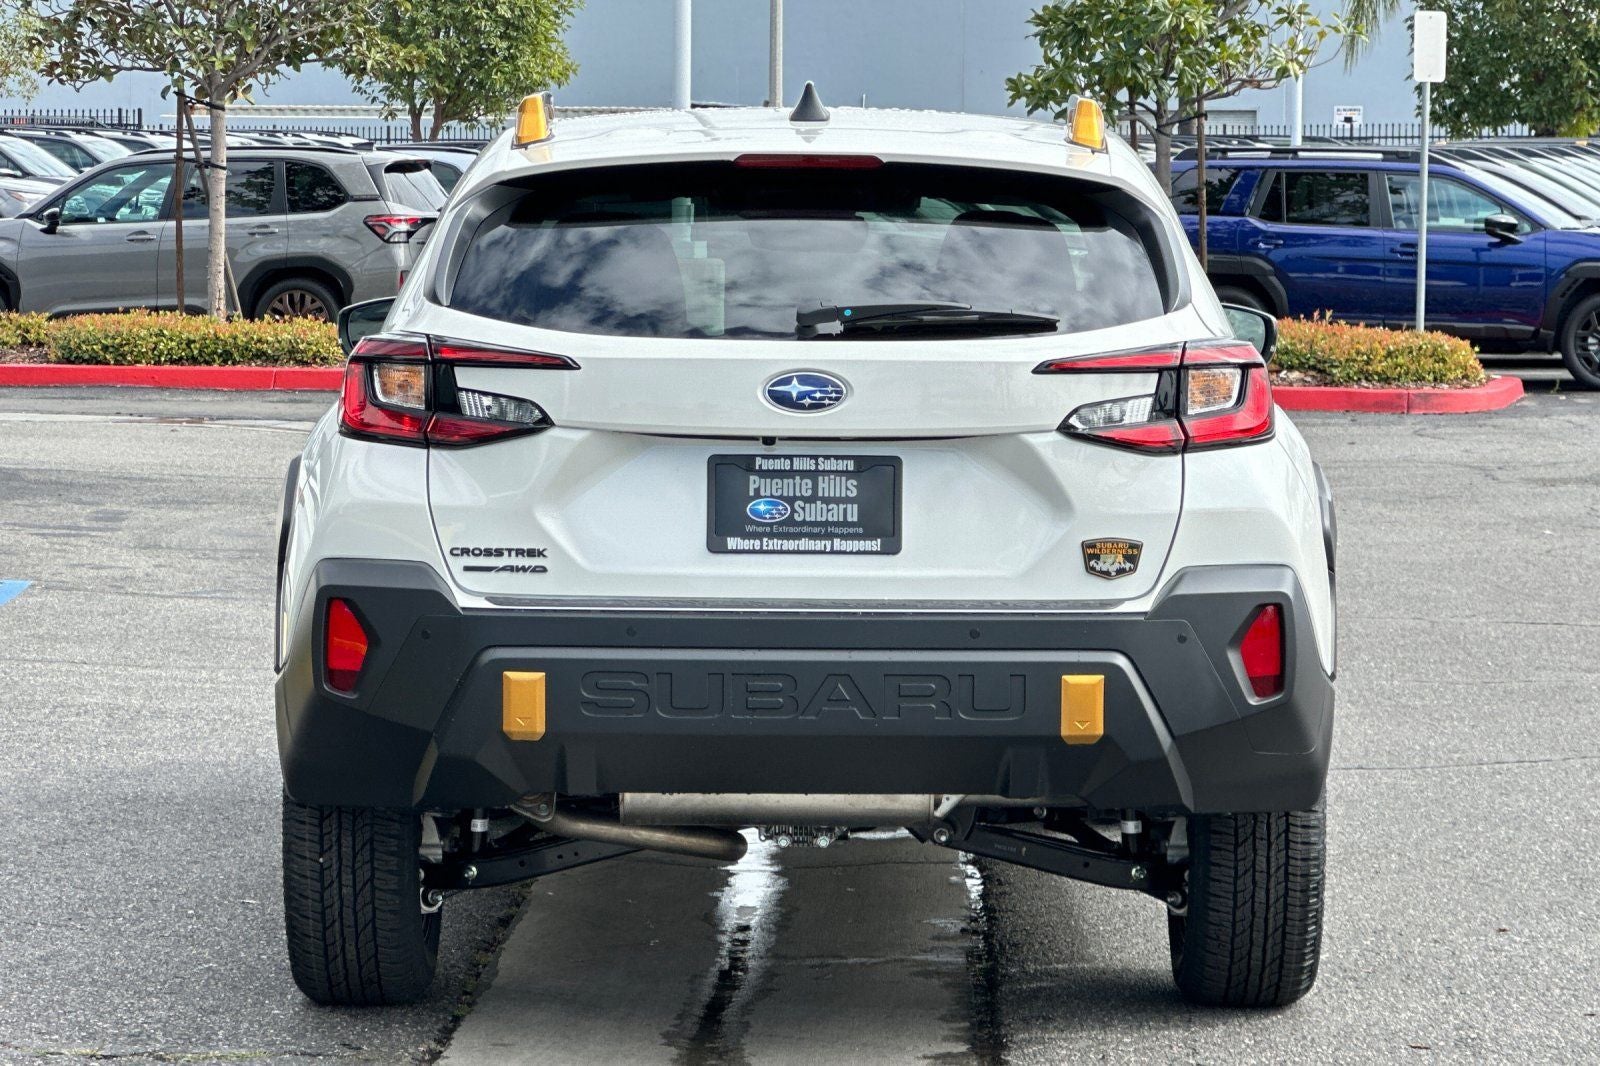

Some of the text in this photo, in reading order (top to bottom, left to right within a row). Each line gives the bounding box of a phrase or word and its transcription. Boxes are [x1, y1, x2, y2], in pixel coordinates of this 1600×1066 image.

[755, 457, 854, 471] Puente Hills Subaru
[749, 475, 858, 497] Puente Hills
[793, 500, 858, 522] Subaru
[745, 525, 863, 534] Where Extraordinary Happens
[727, 537, 881, 551] Where Extraordinary Happens!
[449, 547, 548, 558] CROSSTREK
[494, 565, 548, 573] AWD
[579, 671, 1026, 721] SUBARU
